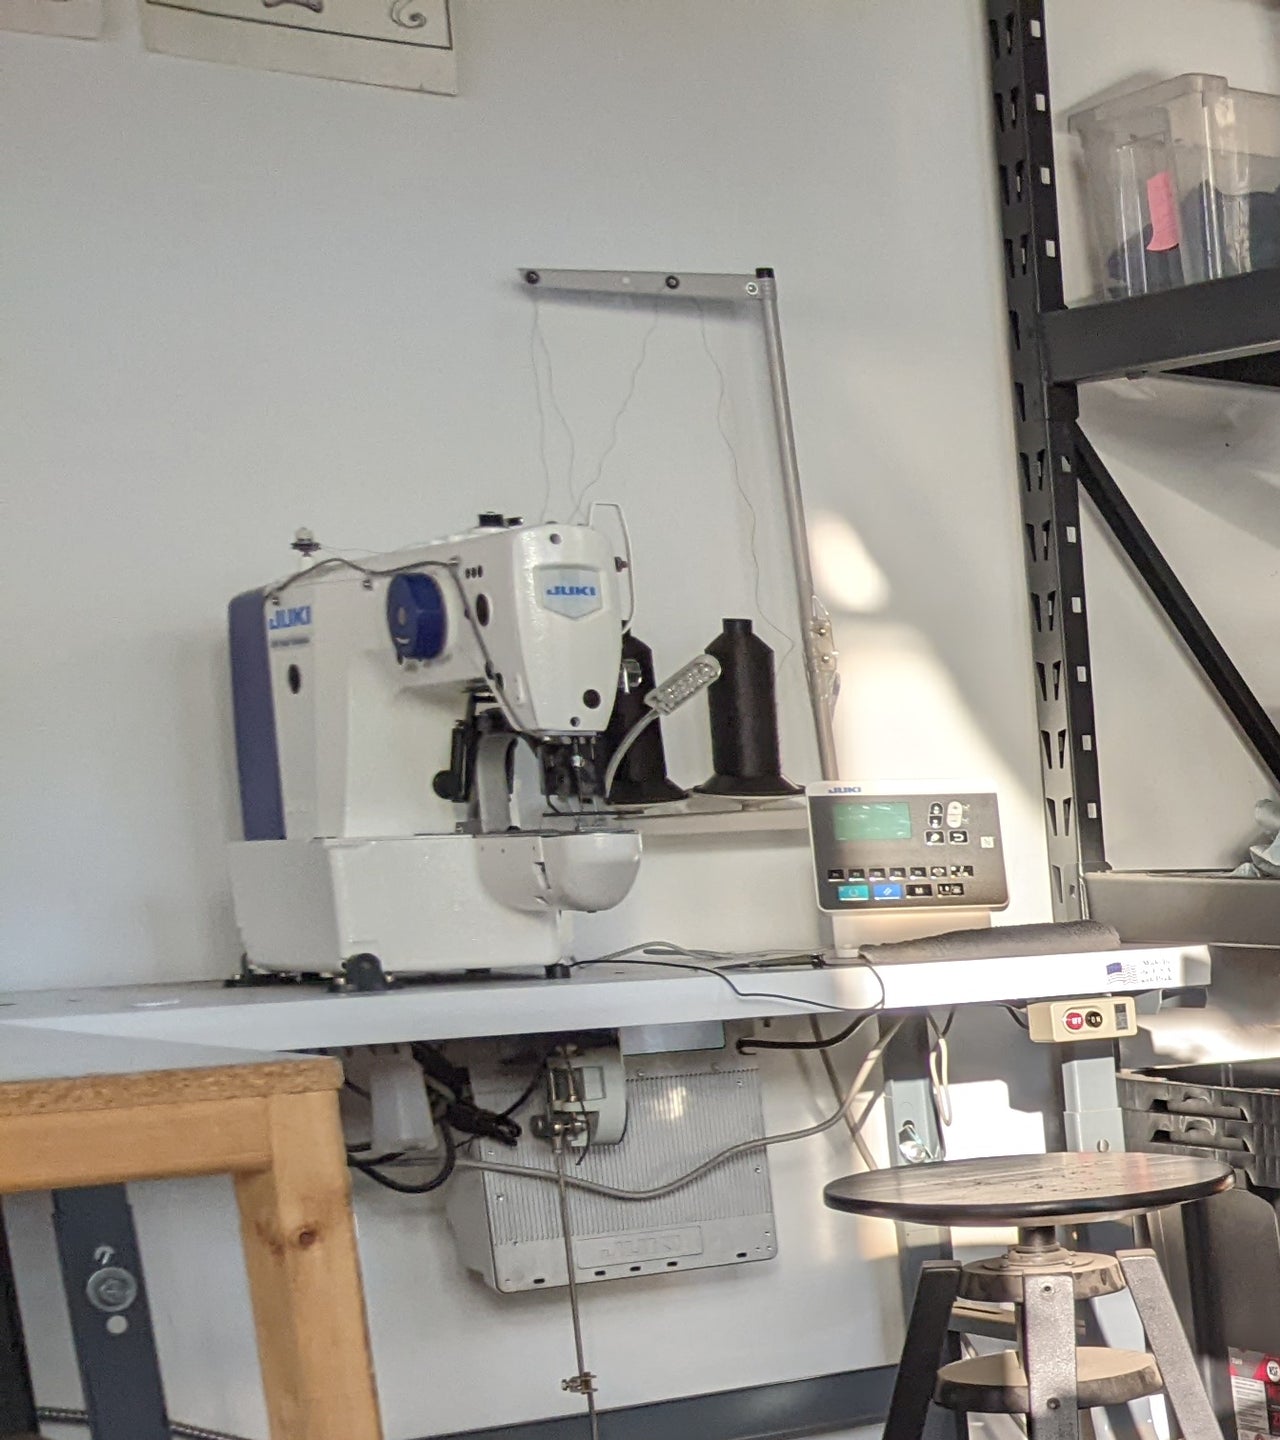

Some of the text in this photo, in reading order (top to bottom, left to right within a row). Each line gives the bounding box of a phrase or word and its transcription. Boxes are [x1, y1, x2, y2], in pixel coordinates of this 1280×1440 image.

[546, 585, 597, 596] JUKI
[268, 605, 312, 630] JUKI
[827, 786, 862, 794] JUKI
